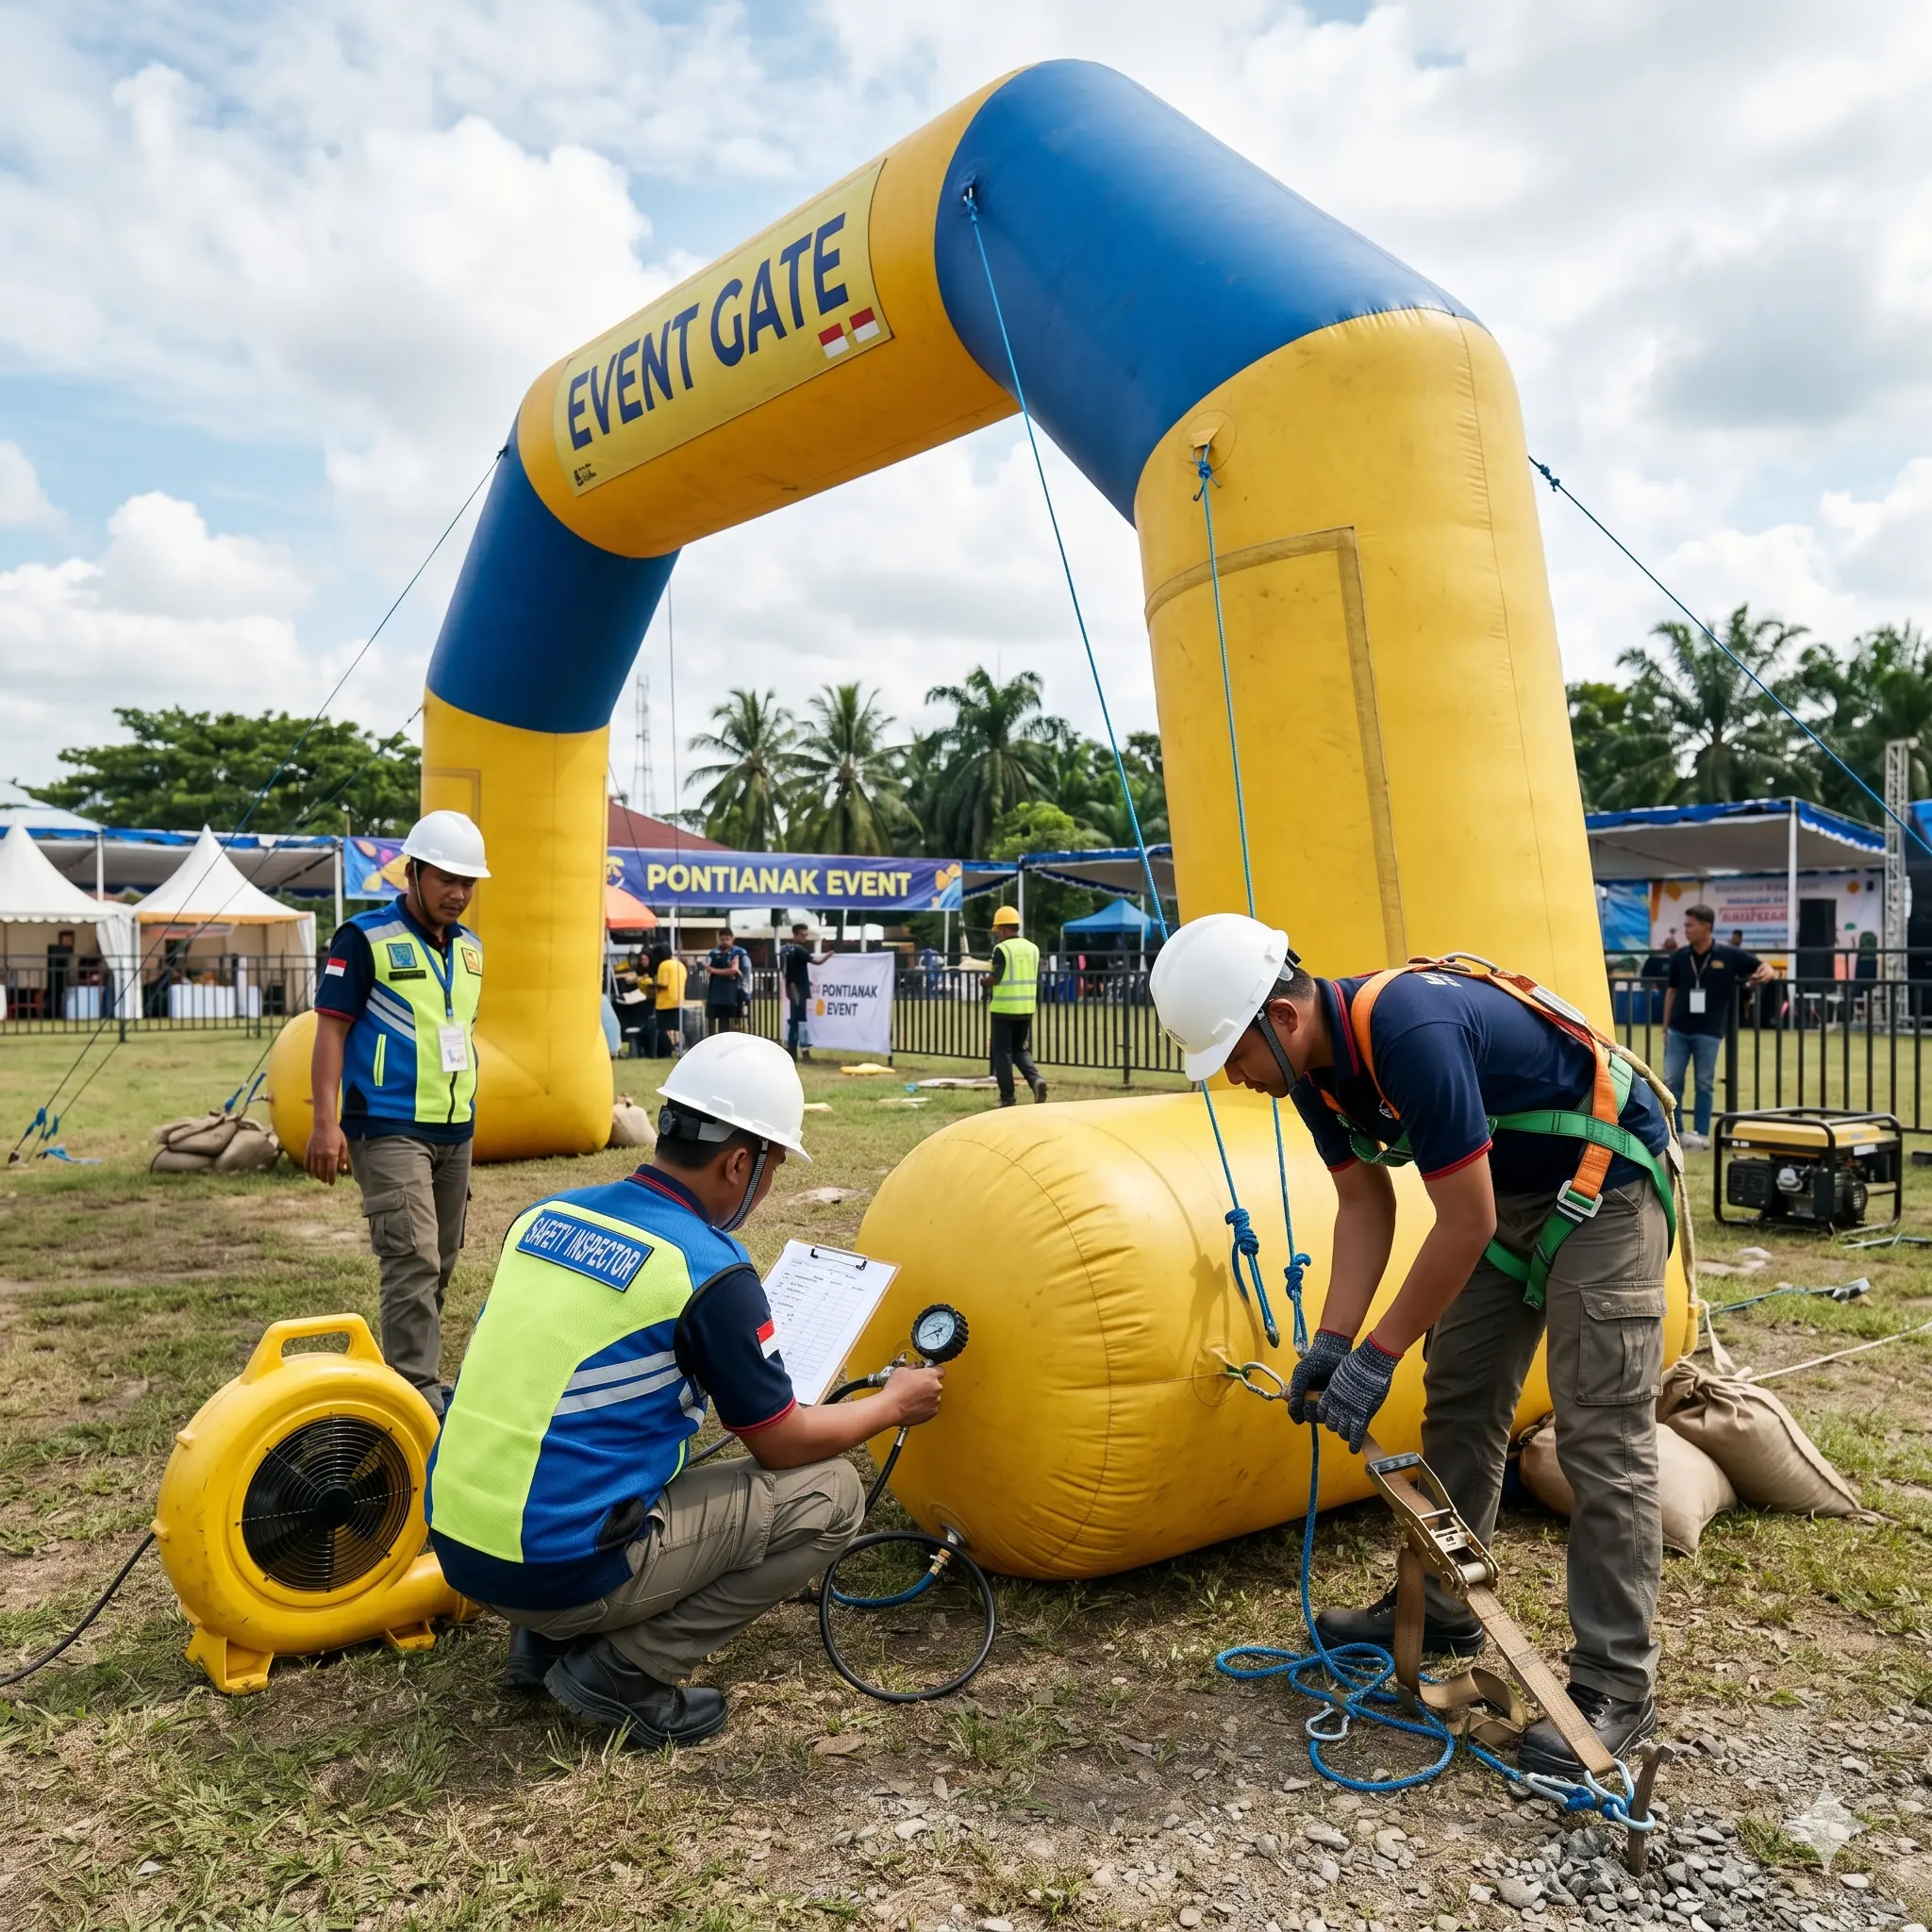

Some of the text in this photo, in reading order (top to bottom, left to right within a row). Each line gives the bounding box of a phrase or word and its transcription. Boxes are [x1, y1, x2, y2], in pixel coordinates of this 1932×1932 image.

[568, 211, 849, 451] EVENT GATE
[647, 864, 912, 896] PONTIANAK EVENT
[822, 984, 878, 998] PONTIANAK
[826, 1002, 858, 1016] EVENT
[525, 1217, 641, 1280] SAFETY INSPECTOR
